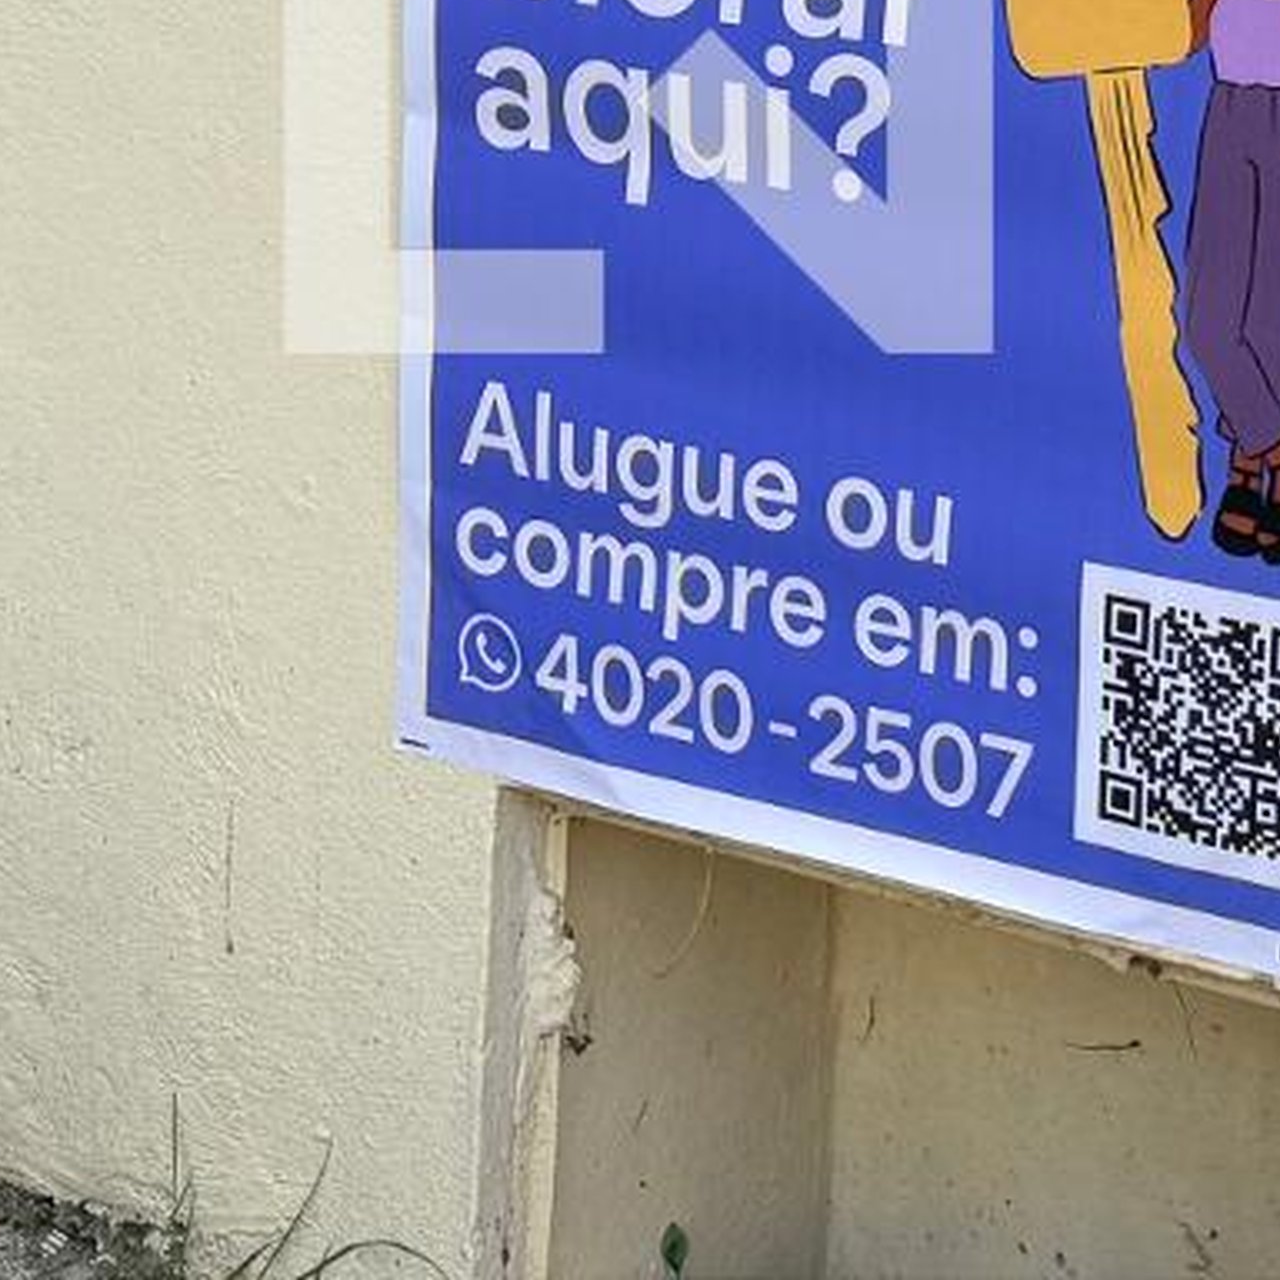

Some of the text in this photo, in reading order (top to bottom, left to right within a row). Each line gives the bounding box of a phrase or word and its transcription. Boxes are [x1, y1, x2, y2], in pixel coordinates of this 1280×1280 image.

[474, 44, 892, 206] aqui?
[460, 382, 953, 565] Alugue ou
[455, 507, 1039, 699] compre em:
